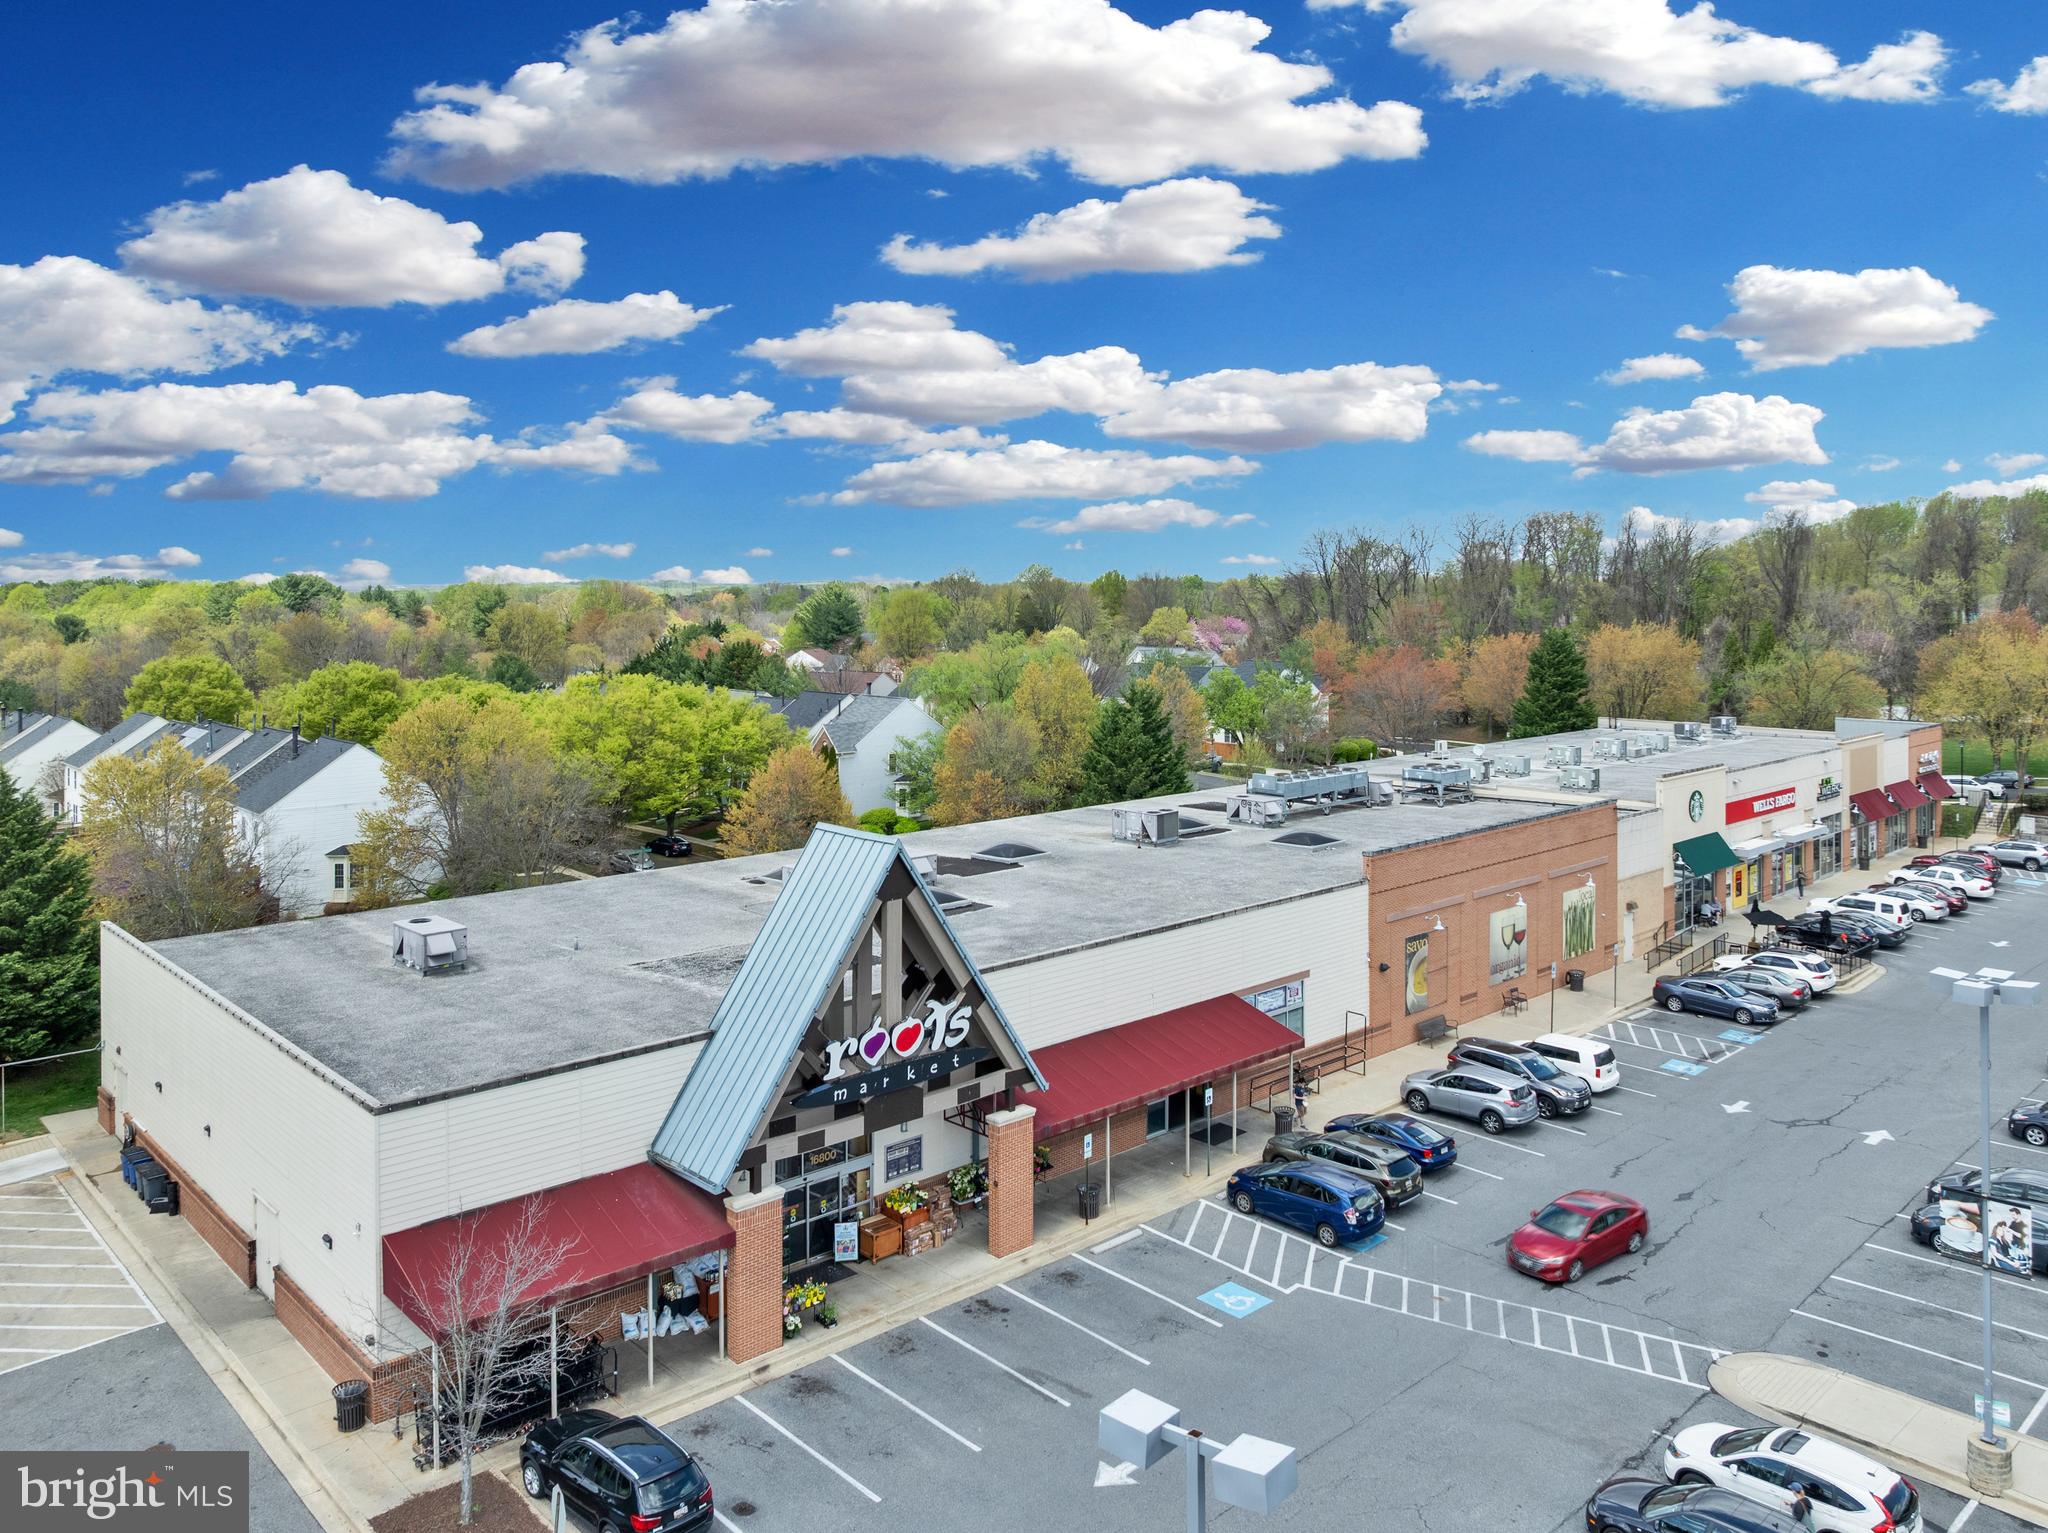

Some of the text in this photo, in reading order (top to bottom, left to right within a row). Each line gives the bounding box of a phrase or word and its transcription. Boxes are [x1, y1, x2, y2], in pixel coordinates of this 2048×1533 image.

[1752, 792, 1796, 813] WELLS FARGO
[823, 1000, 973, 1081] roots
[834, 1054, 960, 1101] market
[810, 1150, 837, 1166] 16800
